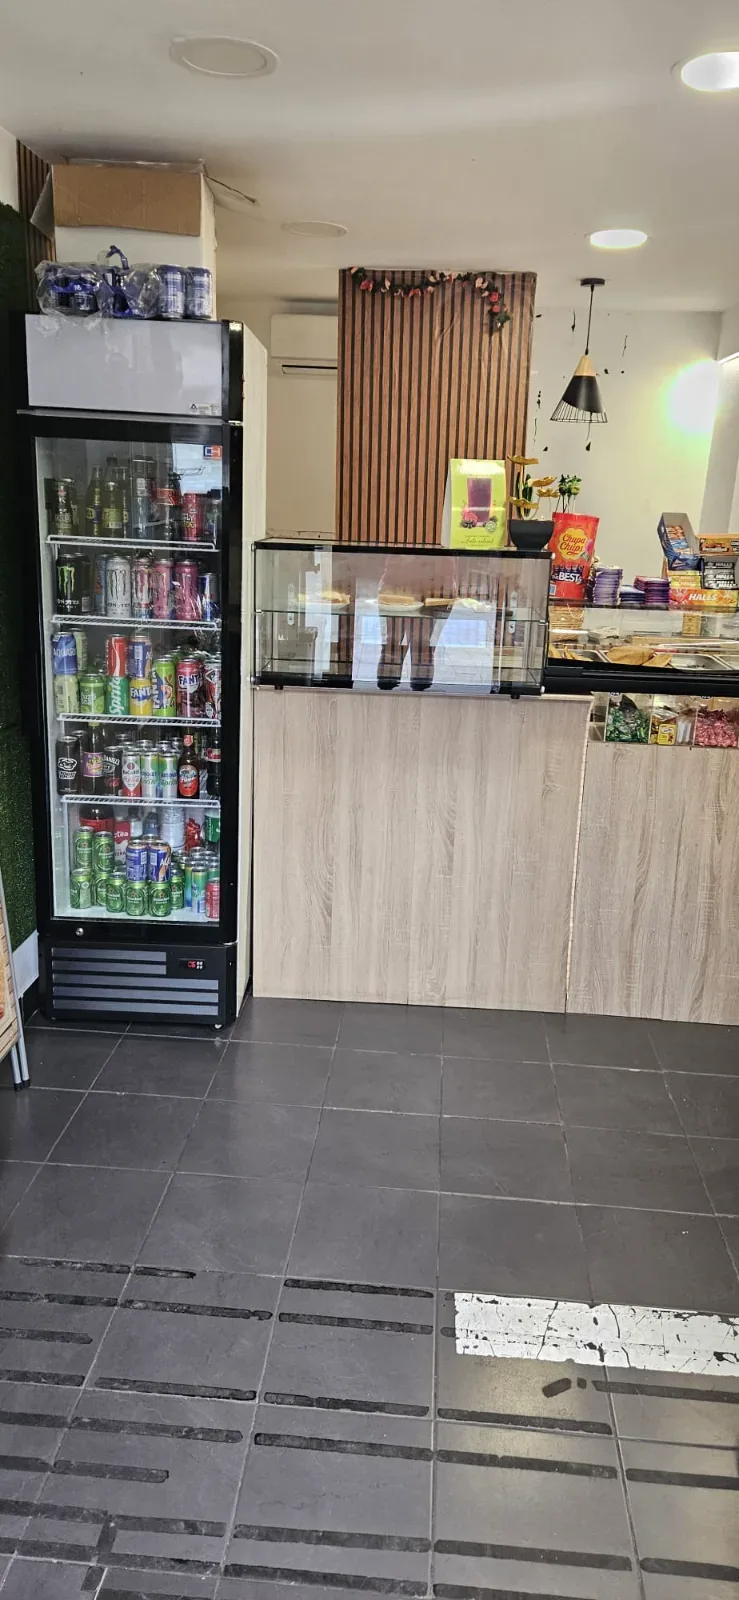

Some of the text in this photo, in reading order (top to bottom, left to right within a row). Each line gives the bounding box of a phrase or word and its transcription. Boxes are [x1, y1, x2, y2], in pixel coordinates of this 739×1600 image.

[562, 533, 586, 545] Chupa
[560, 541, 584, 555] Chups
[559, 571, 580, 582] BEST
[688, 593, 718, 601] HALLS
[178, 674, 199, 686] FANT
[130, 687, 151, 698] FANT
